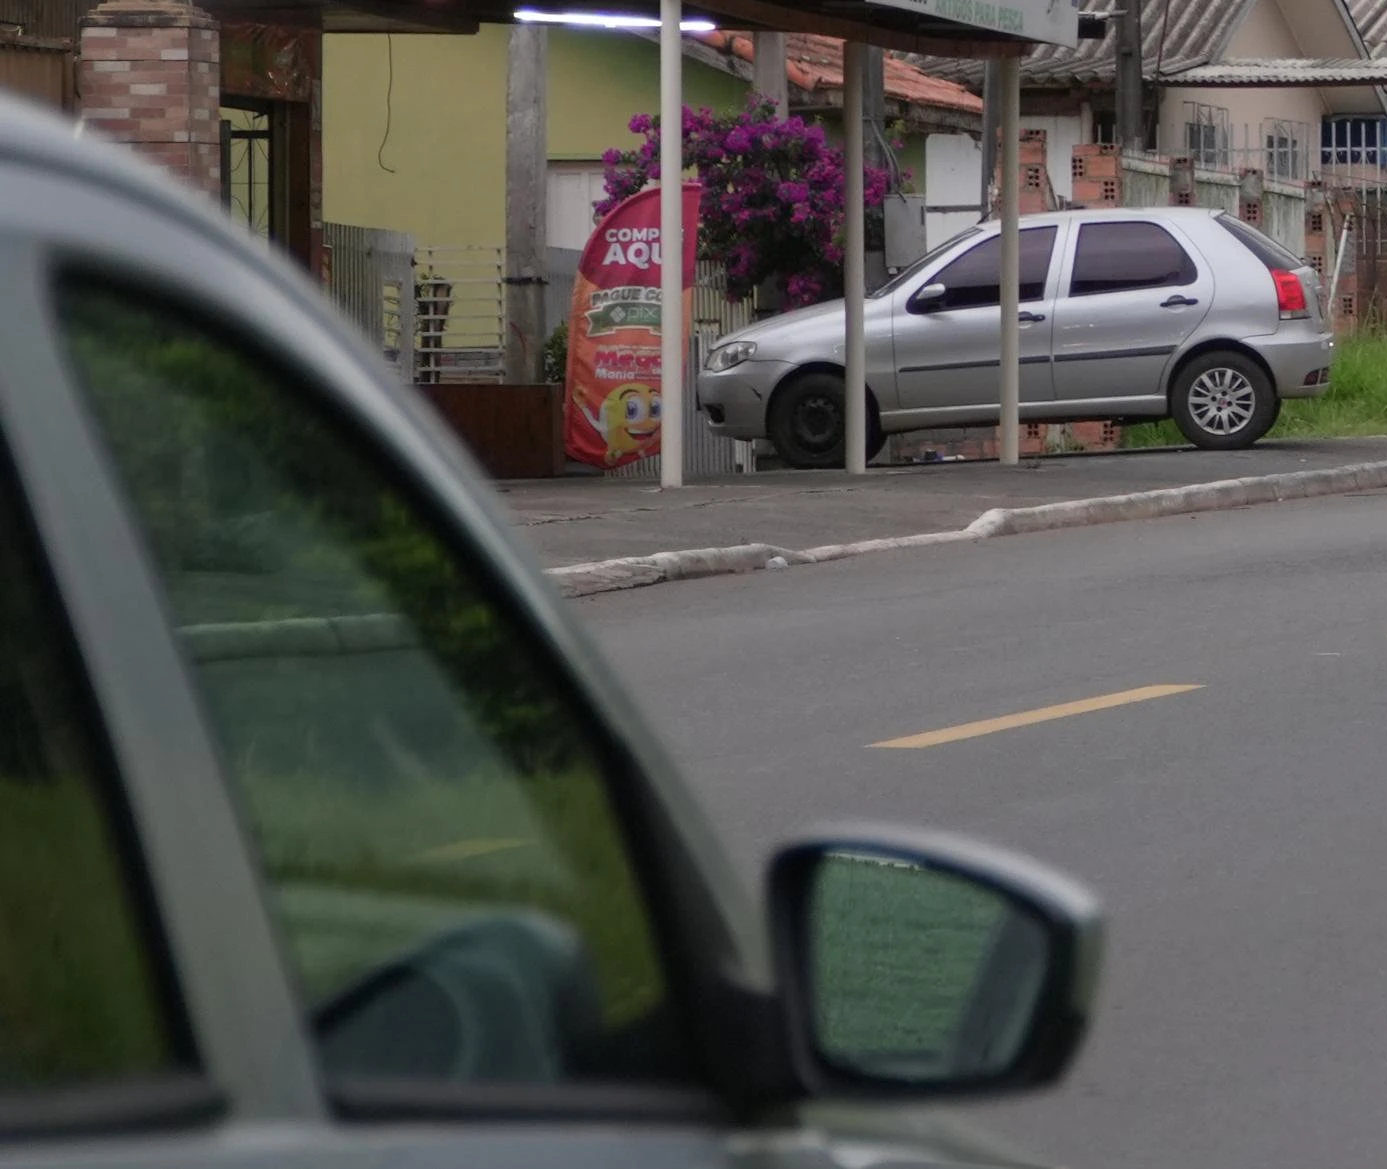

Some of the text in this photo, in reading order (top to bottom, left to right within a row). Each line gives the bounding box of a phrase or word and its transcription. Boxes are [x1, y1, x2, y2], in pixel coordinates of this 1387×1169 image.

[605, 228, 684, 242] COMP
[602, 242, 662, 269] AQU
[592, 287, 642, 306] PAGUE
